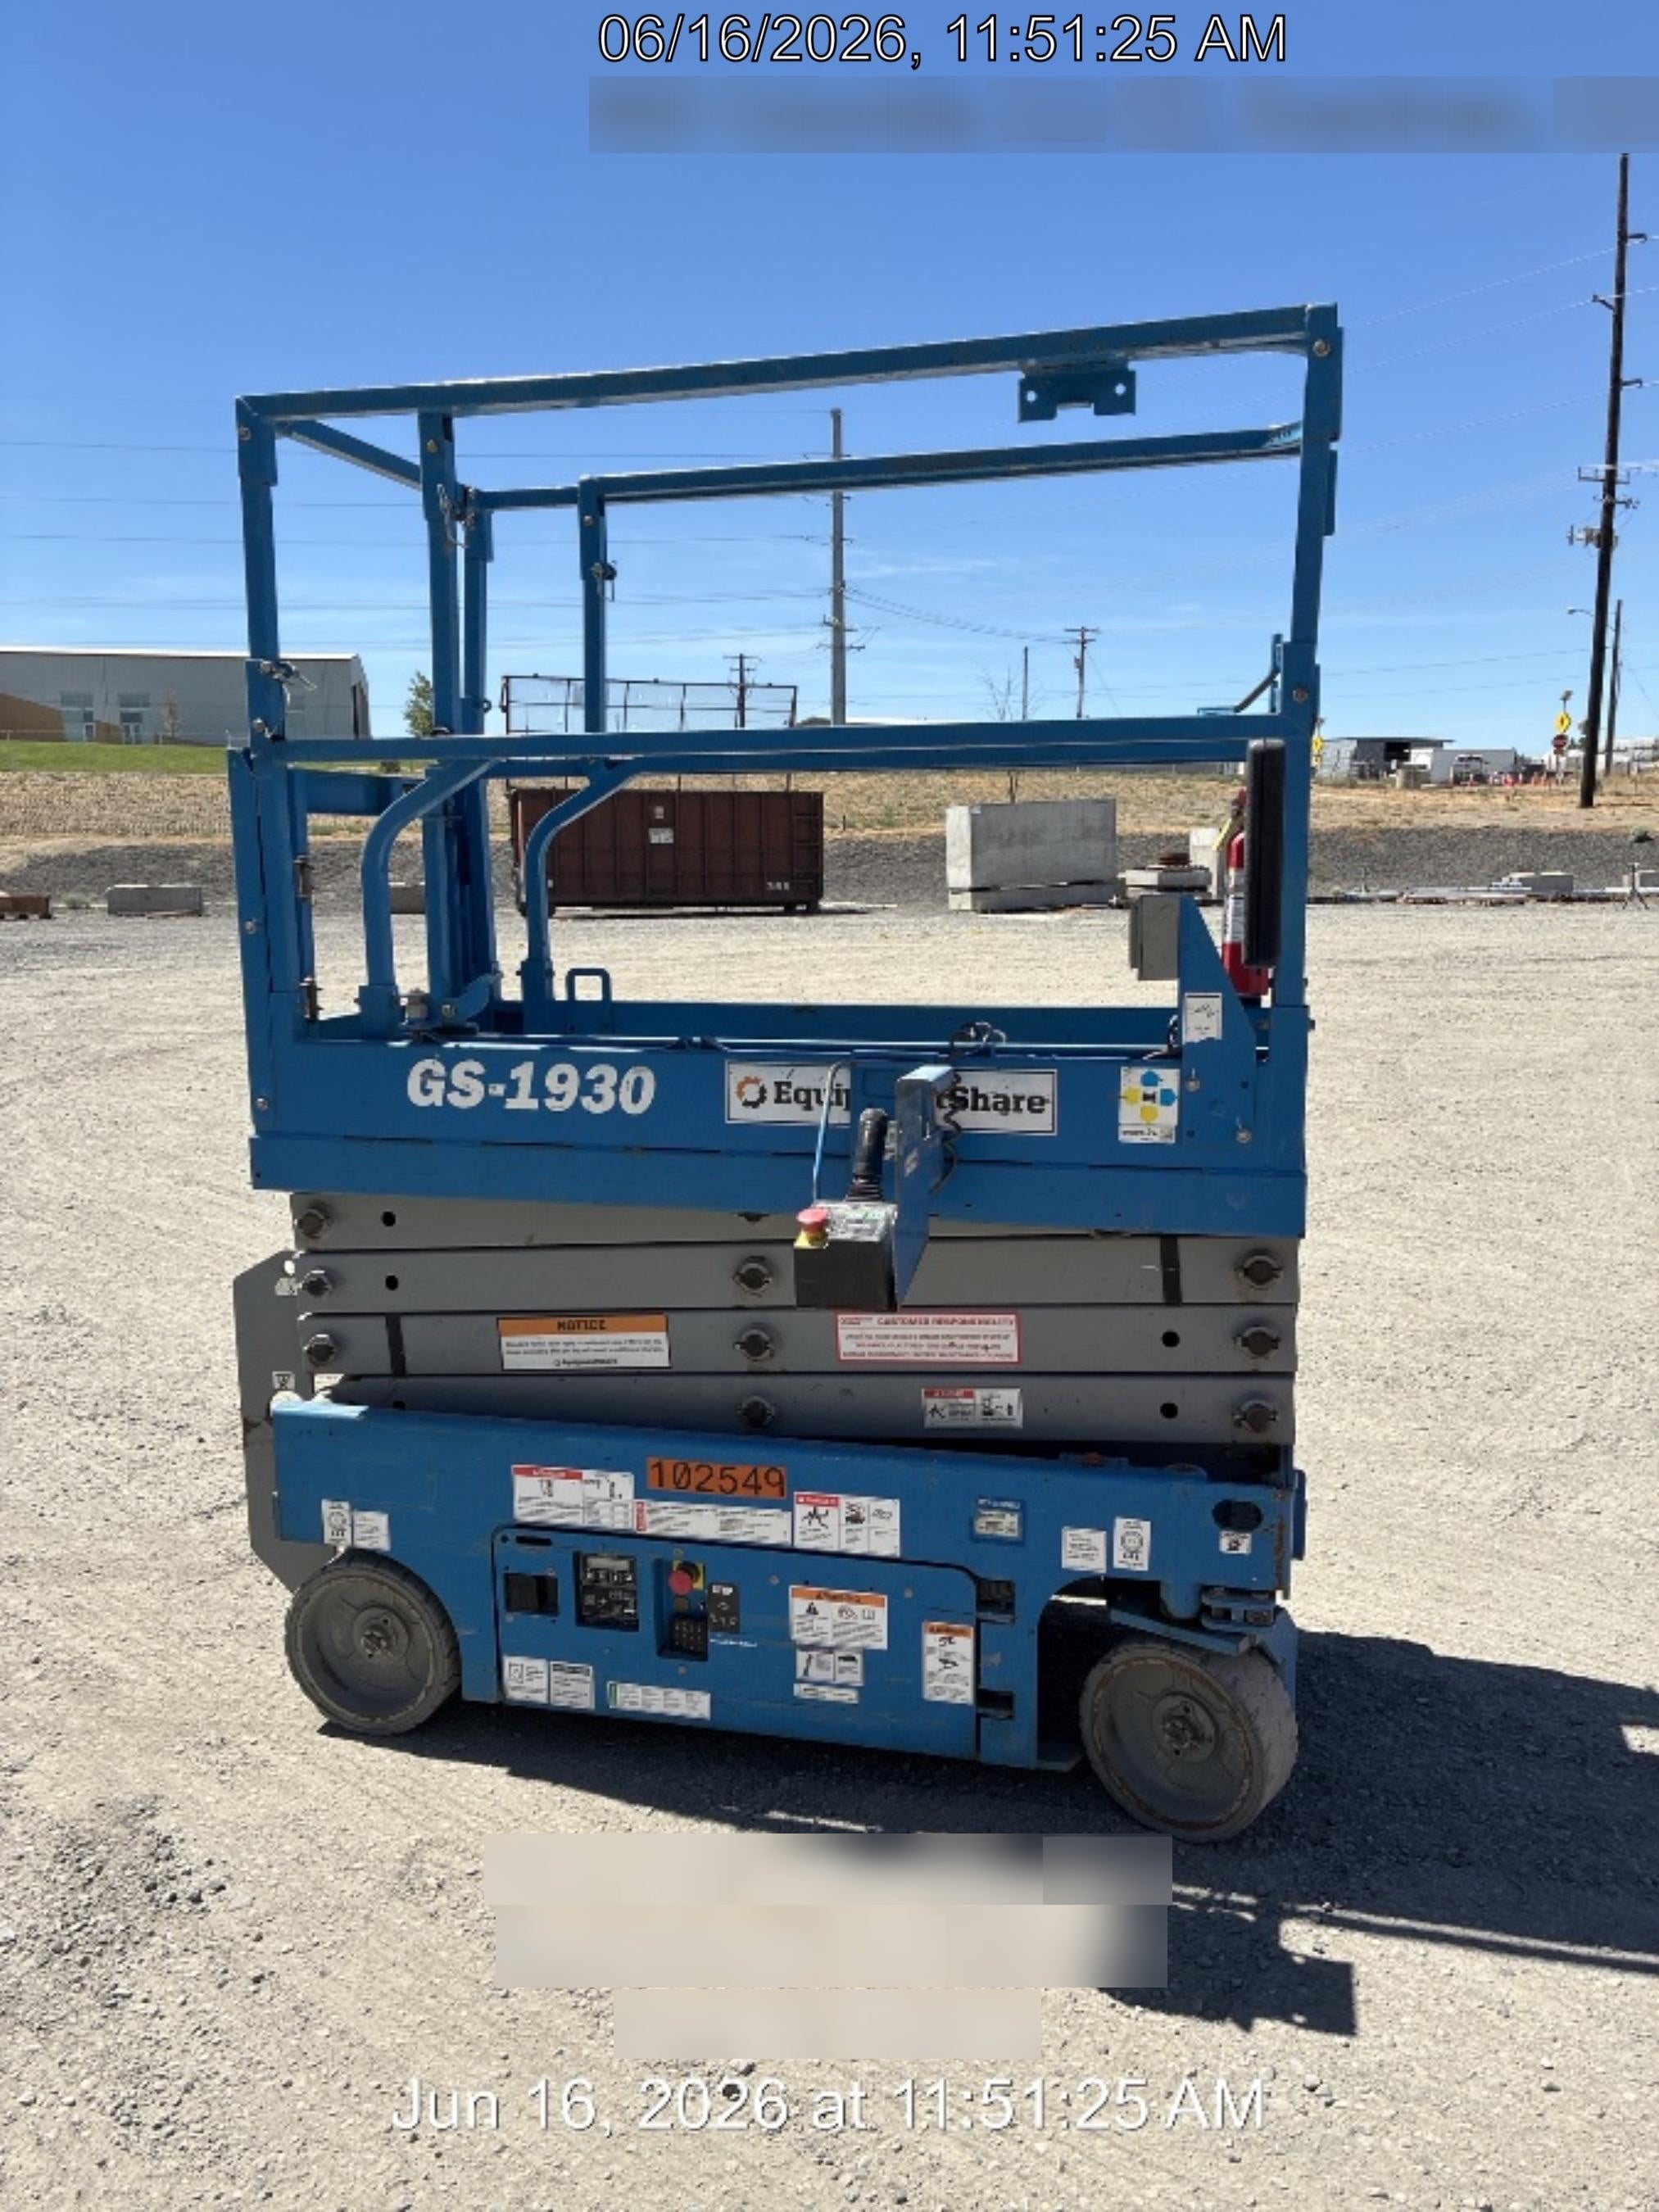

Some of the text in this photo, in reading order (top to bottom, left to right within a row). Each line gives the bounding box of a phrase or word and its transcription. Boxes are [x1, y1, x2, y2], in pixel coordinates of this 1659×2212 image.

[407, 1058, 656, 1115] GS-1930
[557, 1318, 607, 1331] NOTICE
[650, 1462, 786, 1498] 102549
